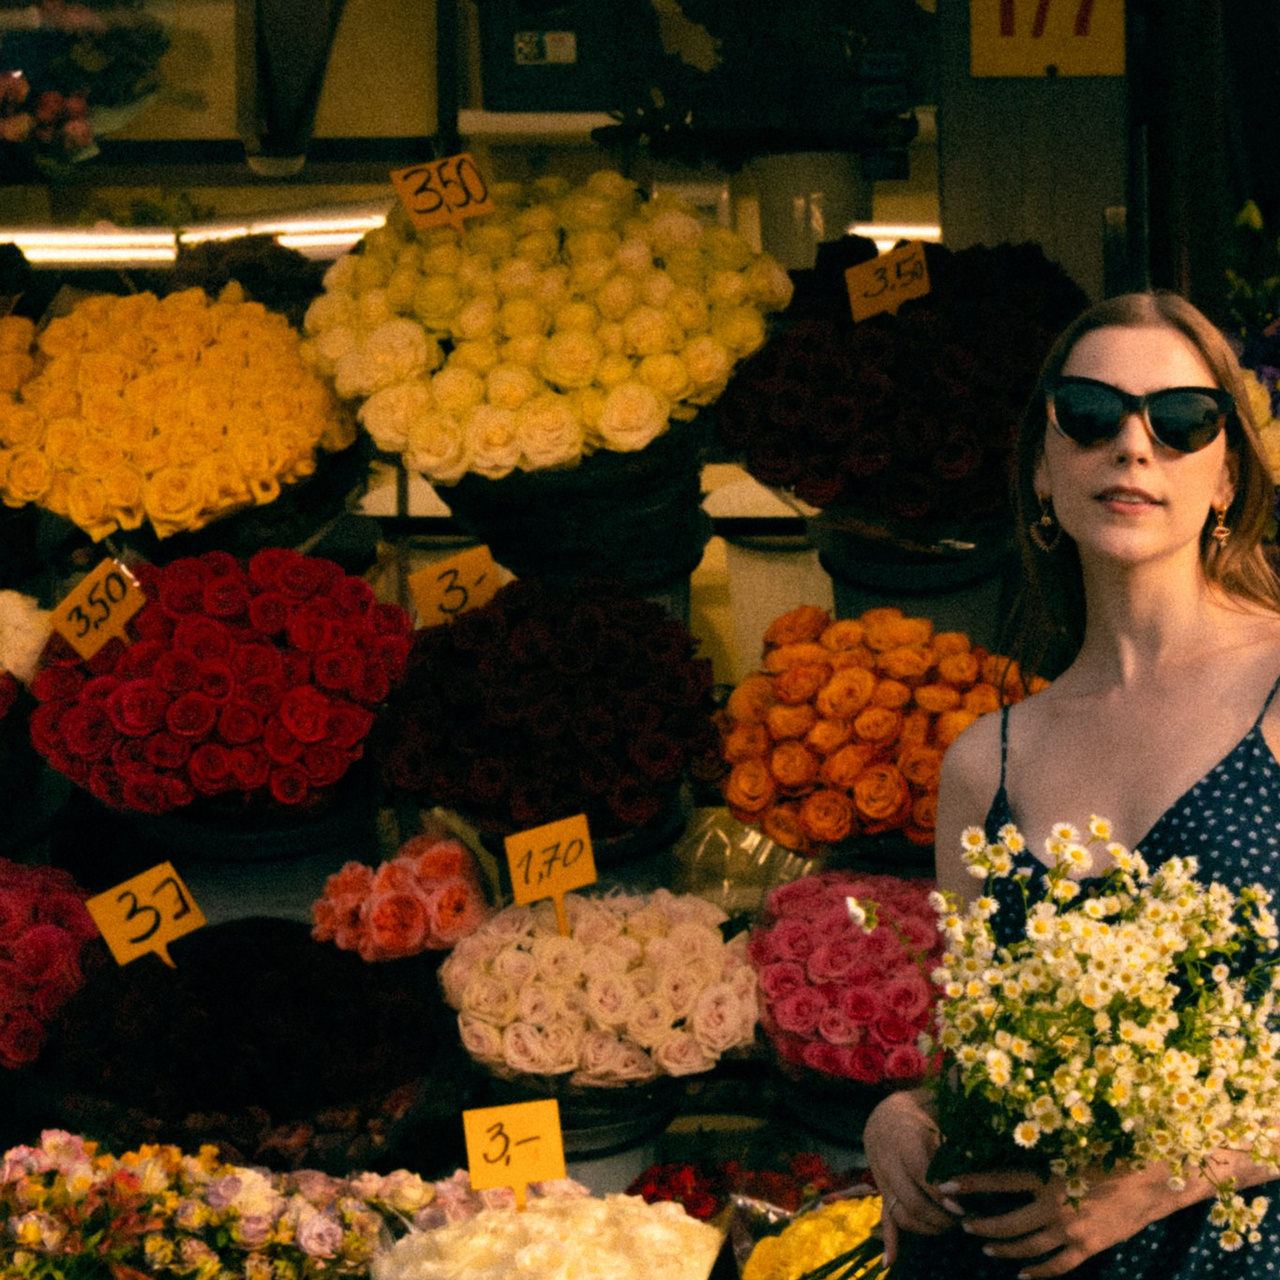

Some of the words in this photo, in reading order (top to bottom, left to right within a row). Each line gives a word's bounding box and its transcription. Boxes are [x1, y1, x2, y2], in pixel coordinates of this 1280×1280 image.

[402, 158, 488, 215] 3,50
[67, 572, 127, 638] 3,50
[516, 838, 584, 885] 1,70
